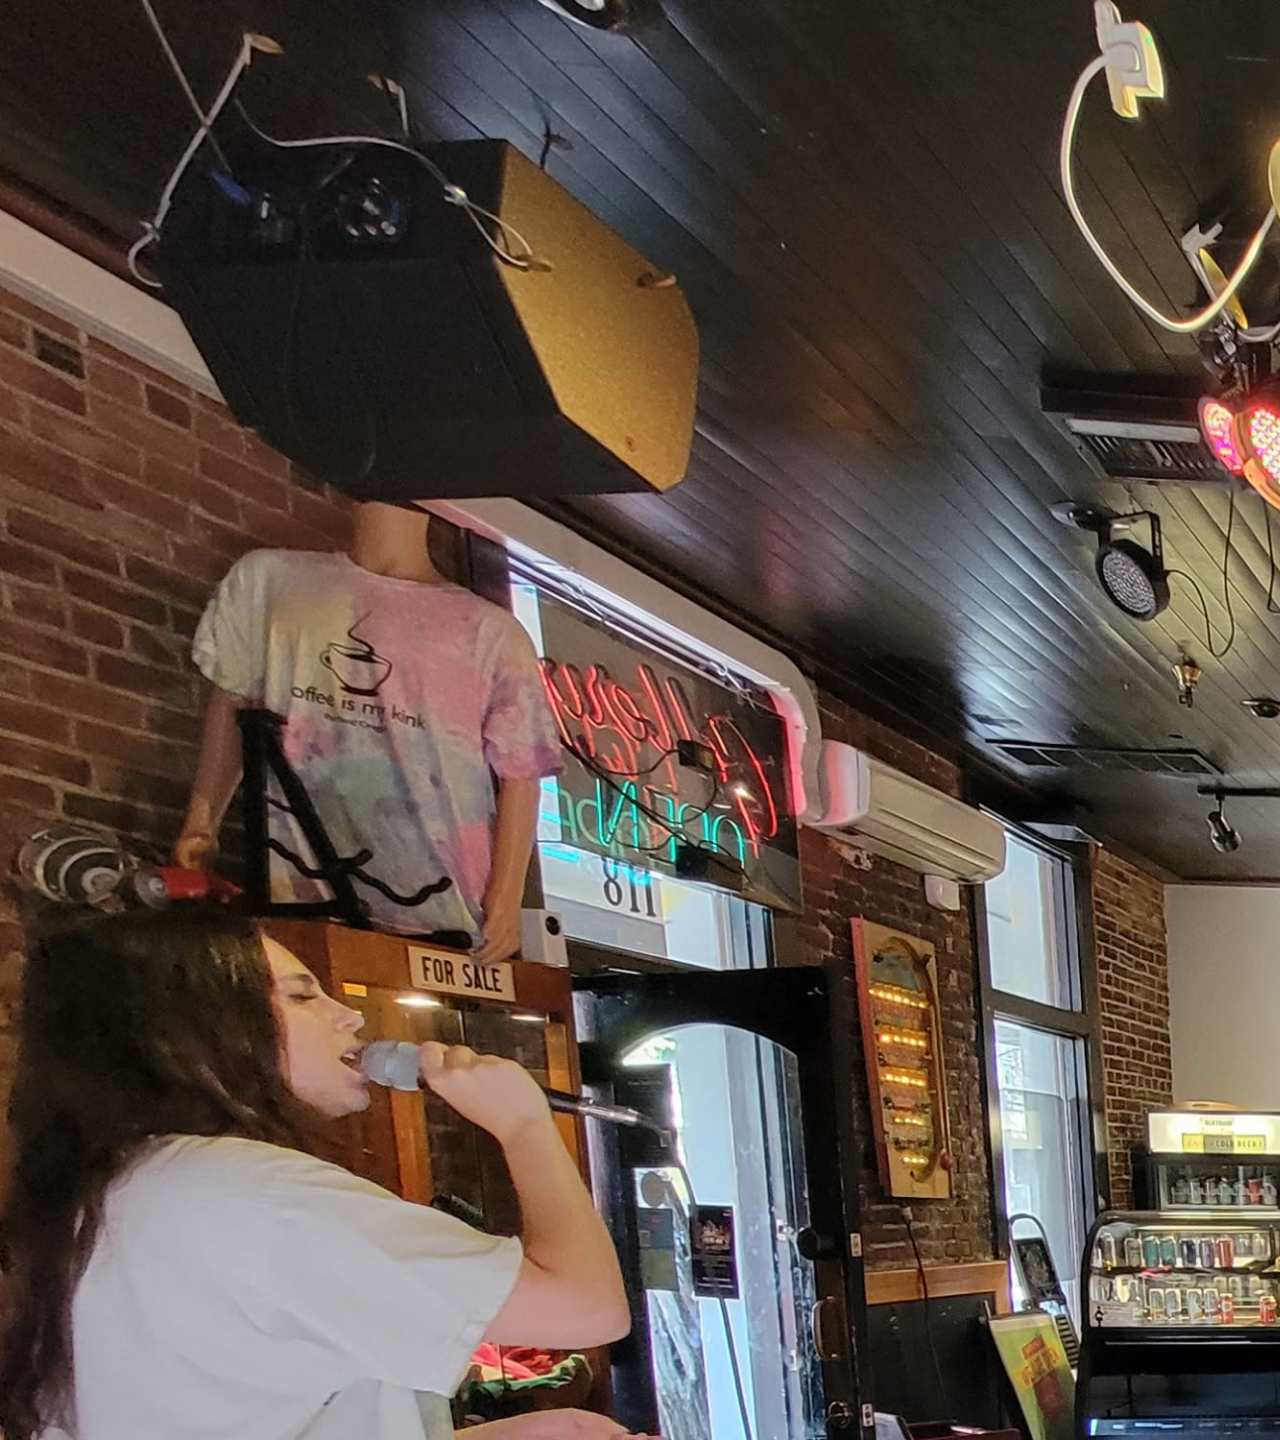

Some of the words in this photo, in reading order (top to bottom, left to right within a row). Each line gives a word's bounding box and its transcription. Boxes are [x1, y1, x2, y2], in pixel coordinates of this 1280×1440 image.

[289, 685, 335, 708] offee
[341, 698, 356, 712] is
[391, 703, 426, 731] kink
[421, 956, 456, 986] FOR
[462, 963, 503, 993] SALE
